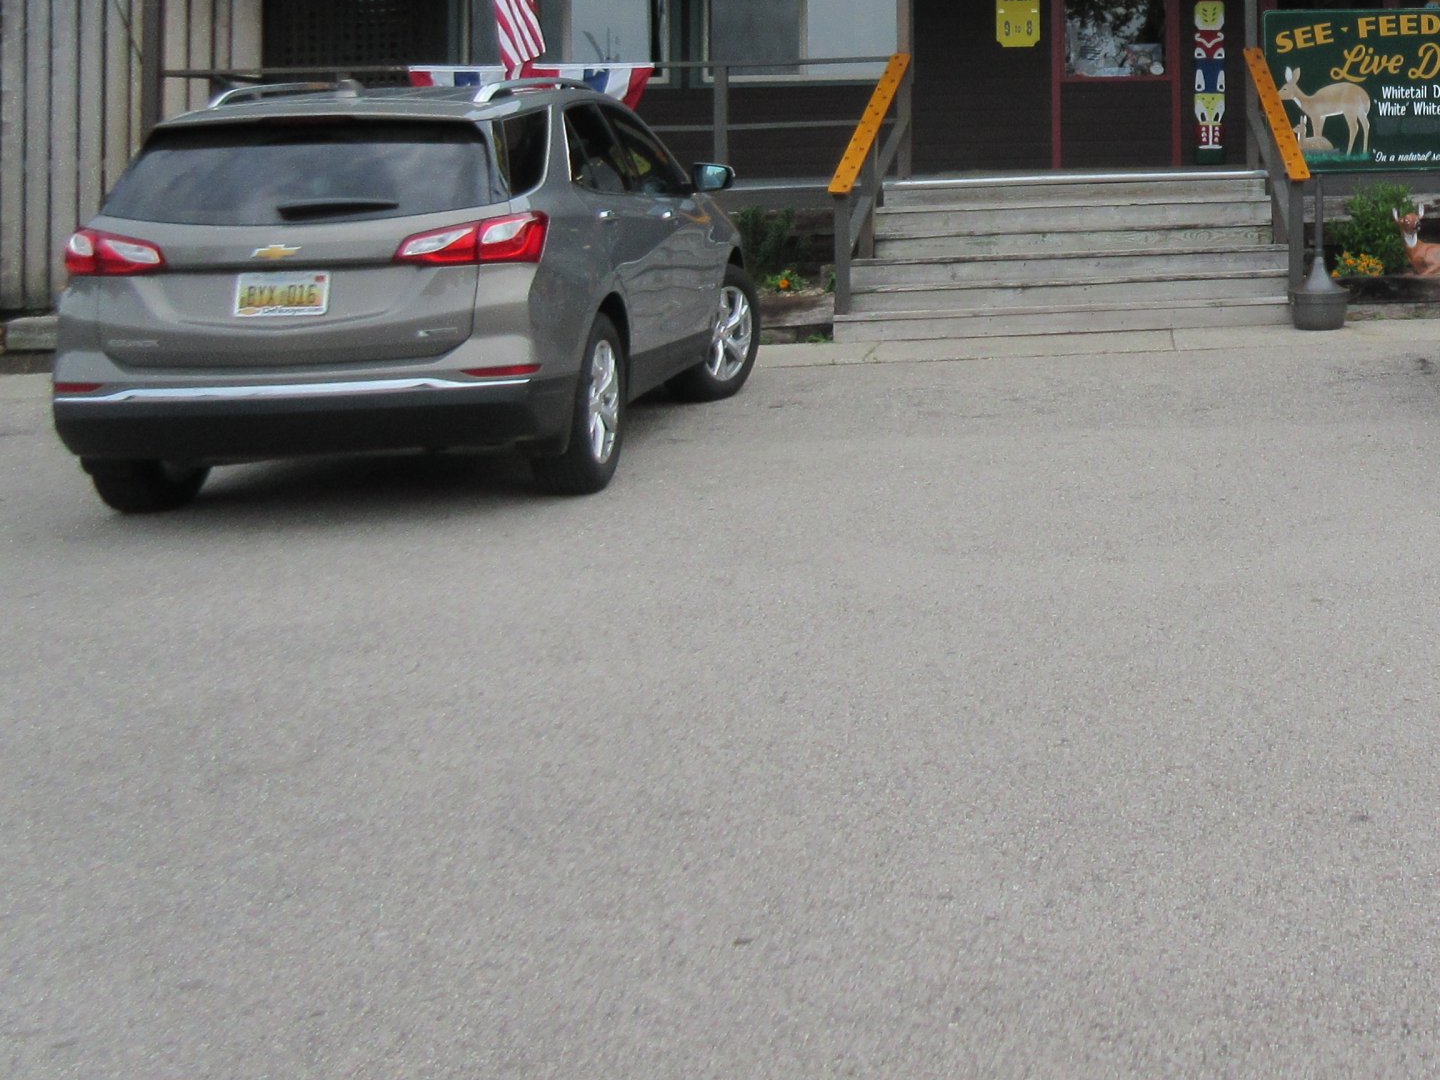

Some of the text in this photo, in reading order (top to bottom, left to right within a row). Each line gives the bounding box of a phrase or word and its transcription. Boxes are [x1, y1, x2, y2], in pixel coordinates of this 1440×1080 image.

[1004, 20, 1011, 36] 9
[1275, 22, 1335, 54] SEE
[1357, 14, 1440, 38] FEED
[1330, 43, 1405, 83] Live
[1381, 85, 1427, 99] Whitetail
[1397, 150, 1432, 162] natural
